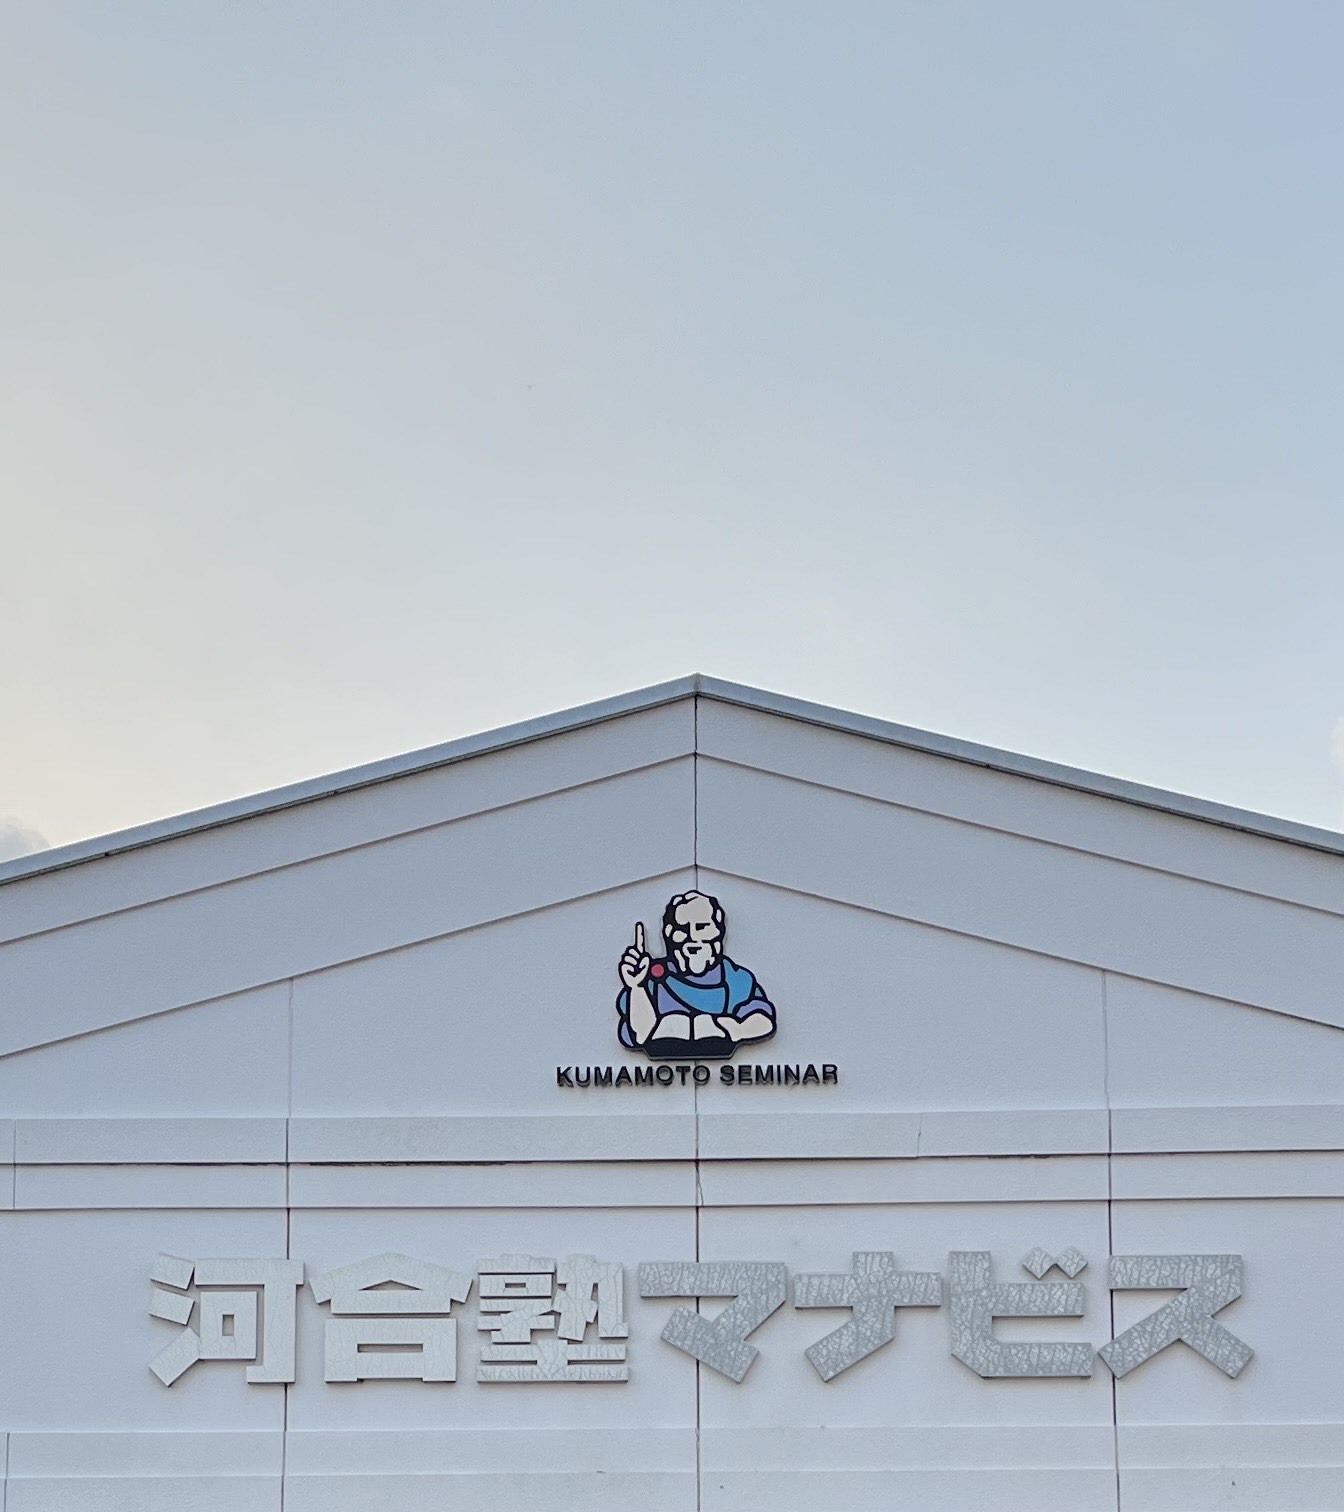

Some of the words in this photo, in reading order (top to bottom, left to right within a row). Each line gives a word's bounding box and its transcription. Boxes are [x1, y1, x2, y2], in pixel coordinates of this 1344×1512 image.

[556, 1065, 711, 1087] KUMAMOTO
[719, 1063, 839, 1086] SEMINAR
[147, 1250, 1256, 1387] 河合塾マナビス
